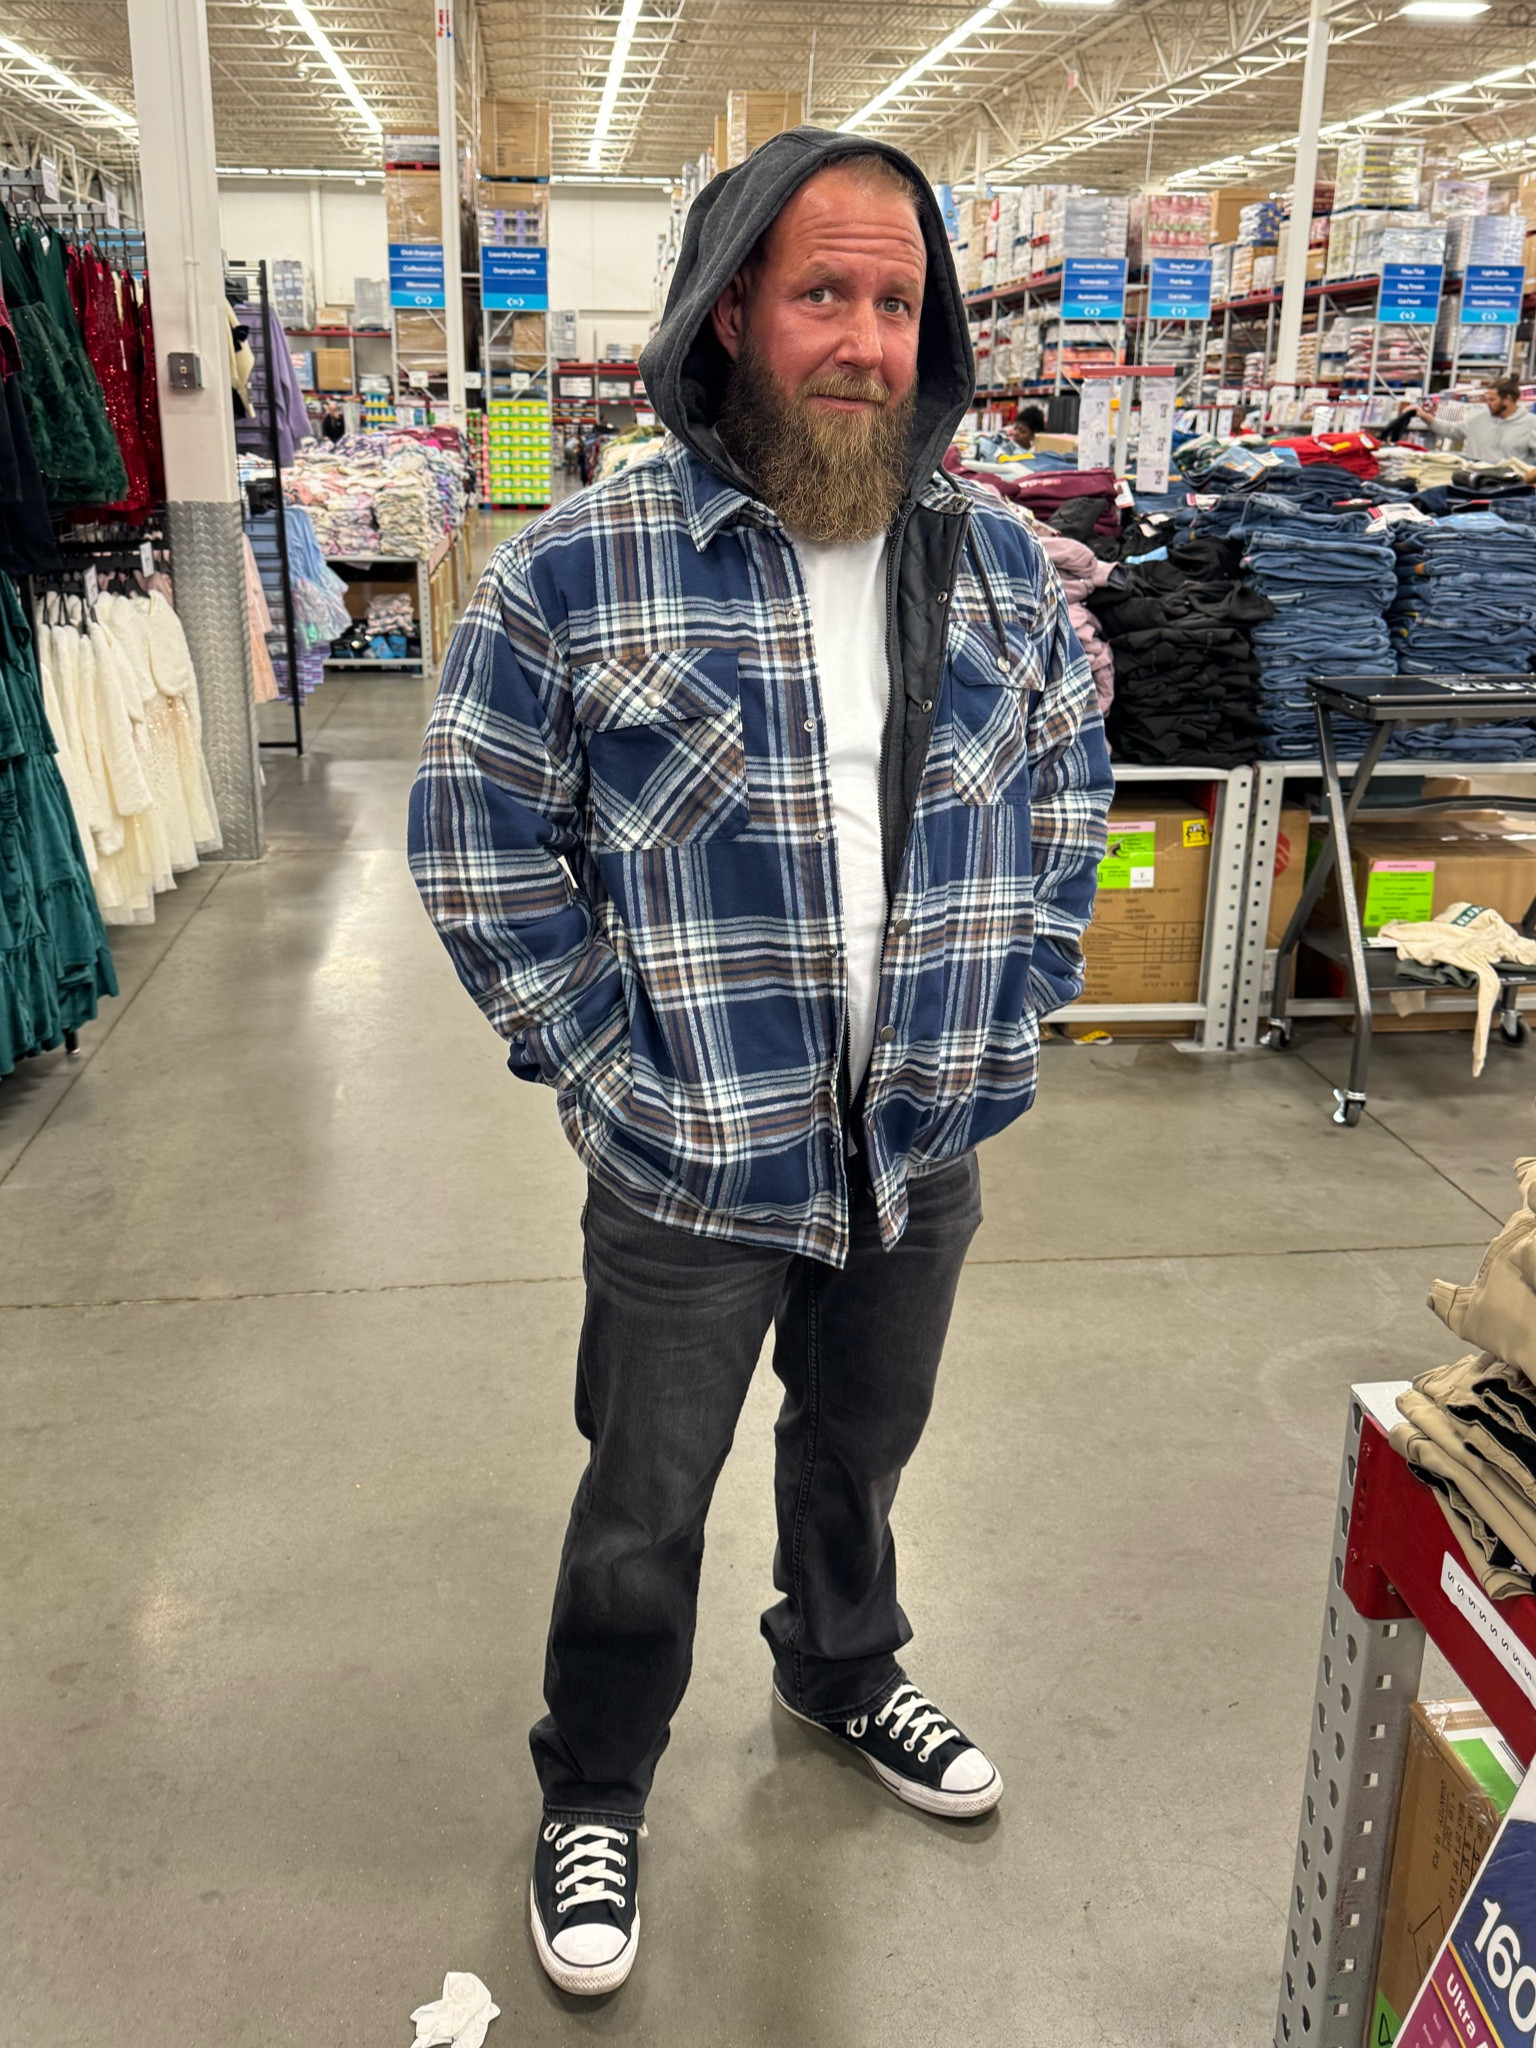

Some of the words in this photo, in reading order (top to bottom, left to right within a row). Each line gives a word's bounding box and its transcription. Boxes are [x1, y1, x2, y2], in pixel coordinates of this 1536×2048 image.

[487, 251, 511, 260] Laundry
[512, 252, 541, 260] Detergent
[492, 267, 520, 276] Detergent
[1447, 1571, 1455, 1584] S
[1457, 1584, 1464, 1596] S
[1468, 1597, 1476, 1609] S
[1479, 1610, 1487, 1623] S
[1490, 1624, 1497, 1637] S
[1501, 1638, 1509, 1651] S
[1513, 1652, 1521, 1665] S
[1524, 1667, 1532, 1680] S
[1446, 1972, 1476, 2040] Ultra
